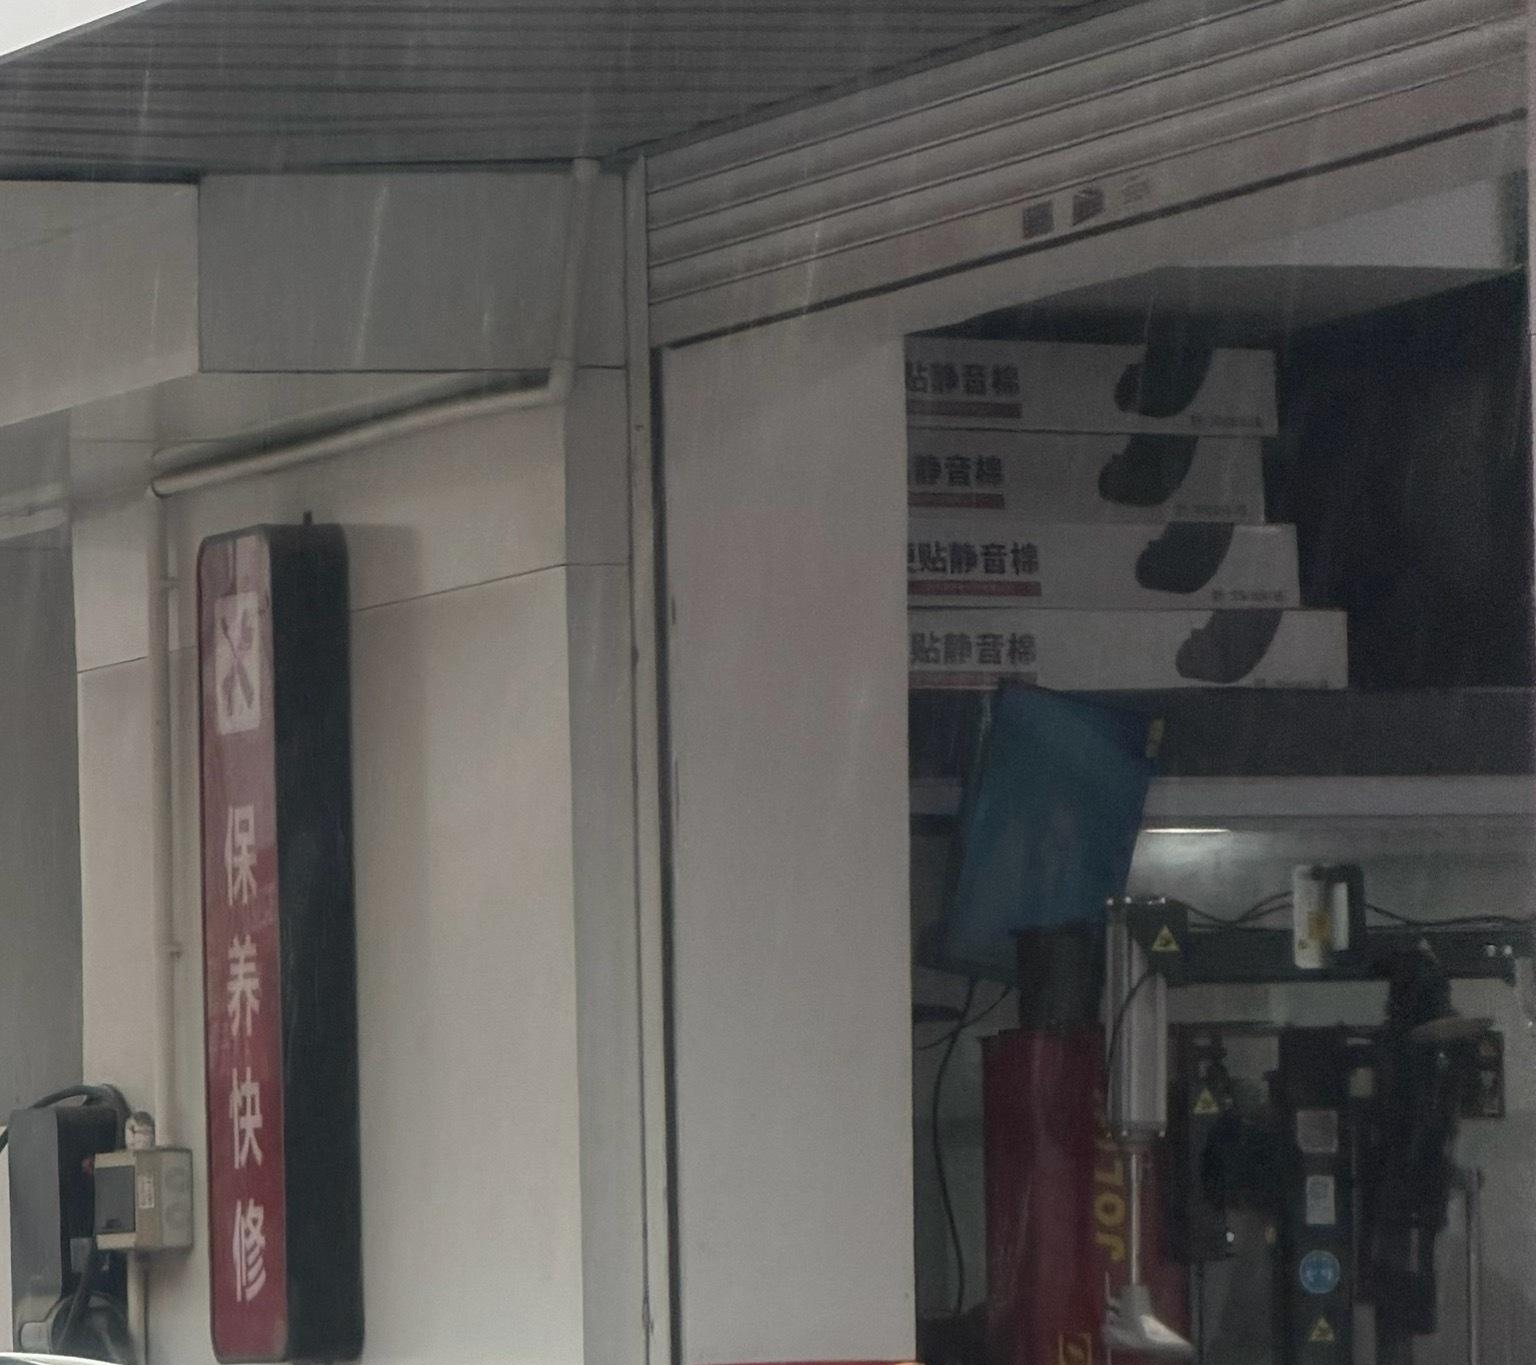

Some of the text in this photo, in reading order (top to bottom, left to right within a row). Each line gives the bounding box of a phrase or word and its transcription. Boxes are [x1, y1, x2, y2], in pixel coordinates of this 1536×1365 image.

[223, 804, 267, 1304] 保养快修
[1091, 1097, 1126, 1264] JOL
